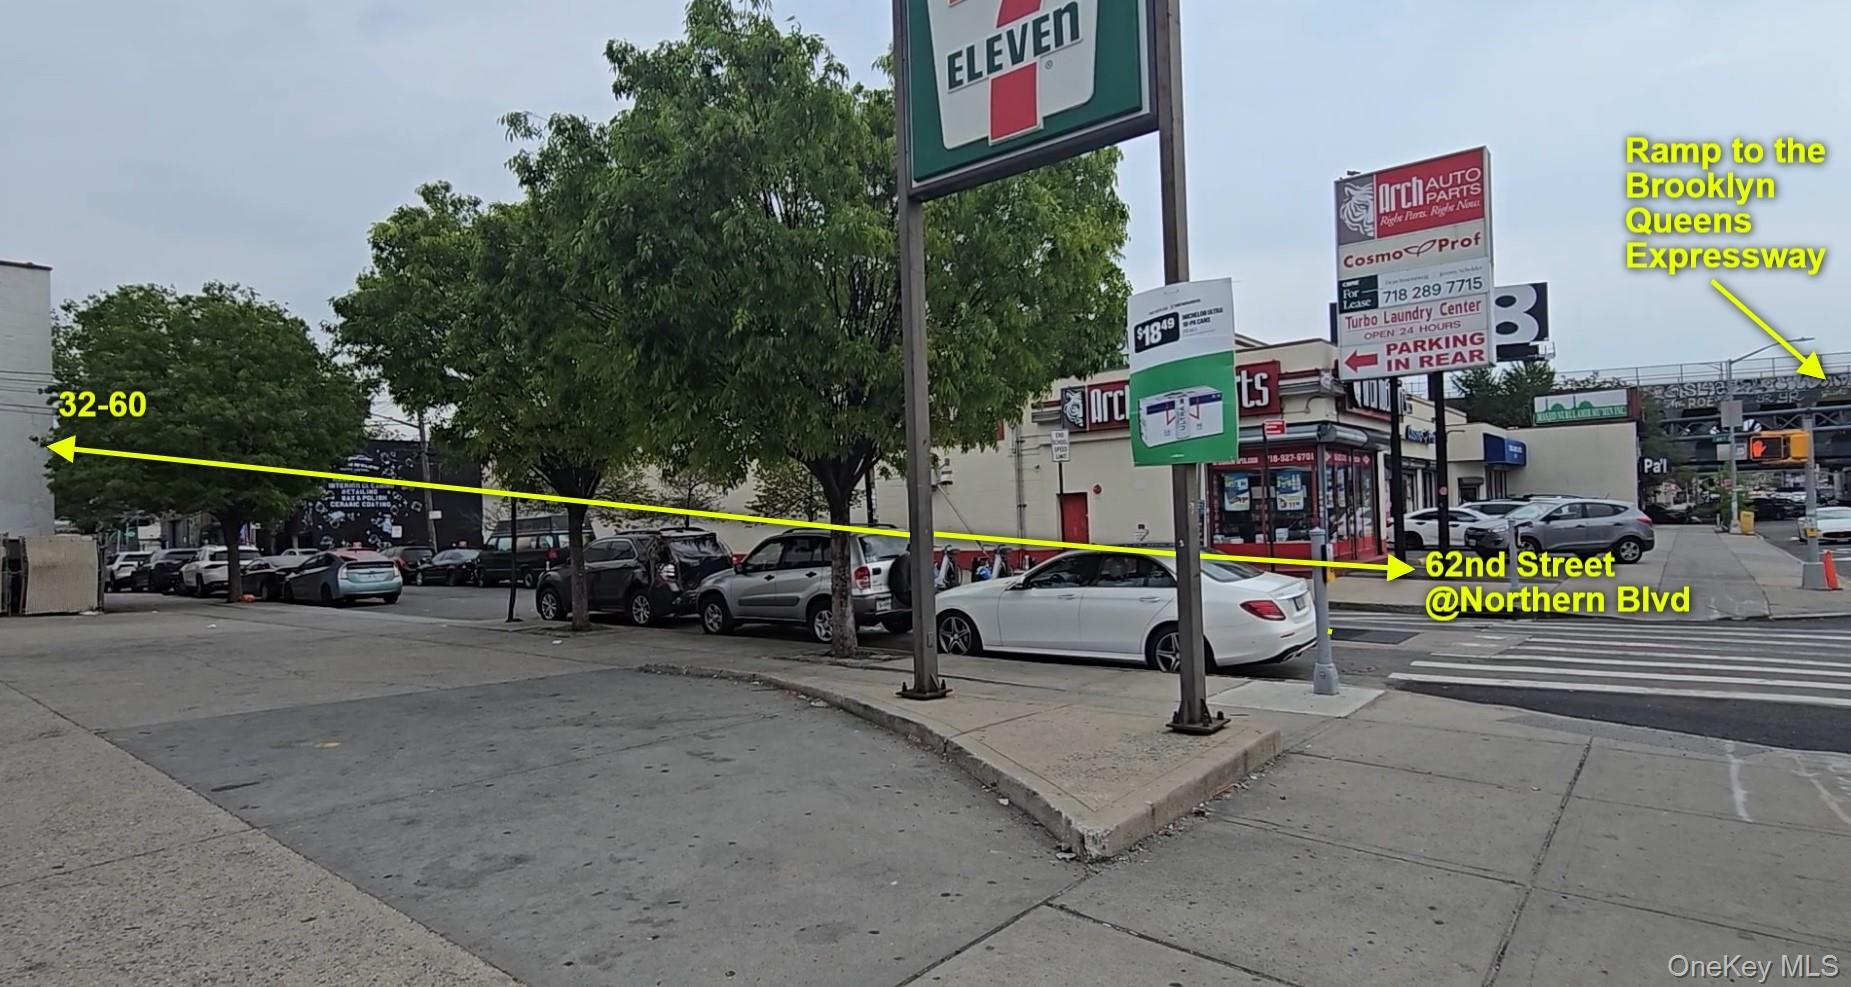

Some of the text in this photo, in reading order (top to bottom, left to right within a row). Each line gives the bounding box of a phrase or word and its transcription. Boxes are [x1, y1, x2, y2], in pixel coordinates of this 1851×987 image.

[1425, 167, 1482, 192] AUTO
[1426, 182, 1482, 205] PARTS
[1380, 211, 1404, 227] Right
[1430, 202, 1455, 217] Right
[1343, 232, 1482, 268] Cosmo Prof
[1343, 289, 1359, 299] For
[1383, 289, 1407, 304] 718
[1412, 283, 1441, 299] 289
[1446, 276, 1483, 294] 7715
[1343, 299, 1371, 310] Lease
[1345, 300, 1481, 329] Turbo Laundry Center
[1364, 320, 1461, 340] OPEN 24 HOURS
[1386, 332, 1485, 356] PARKING
[1386, 349, 1485, 372] IN REAR
